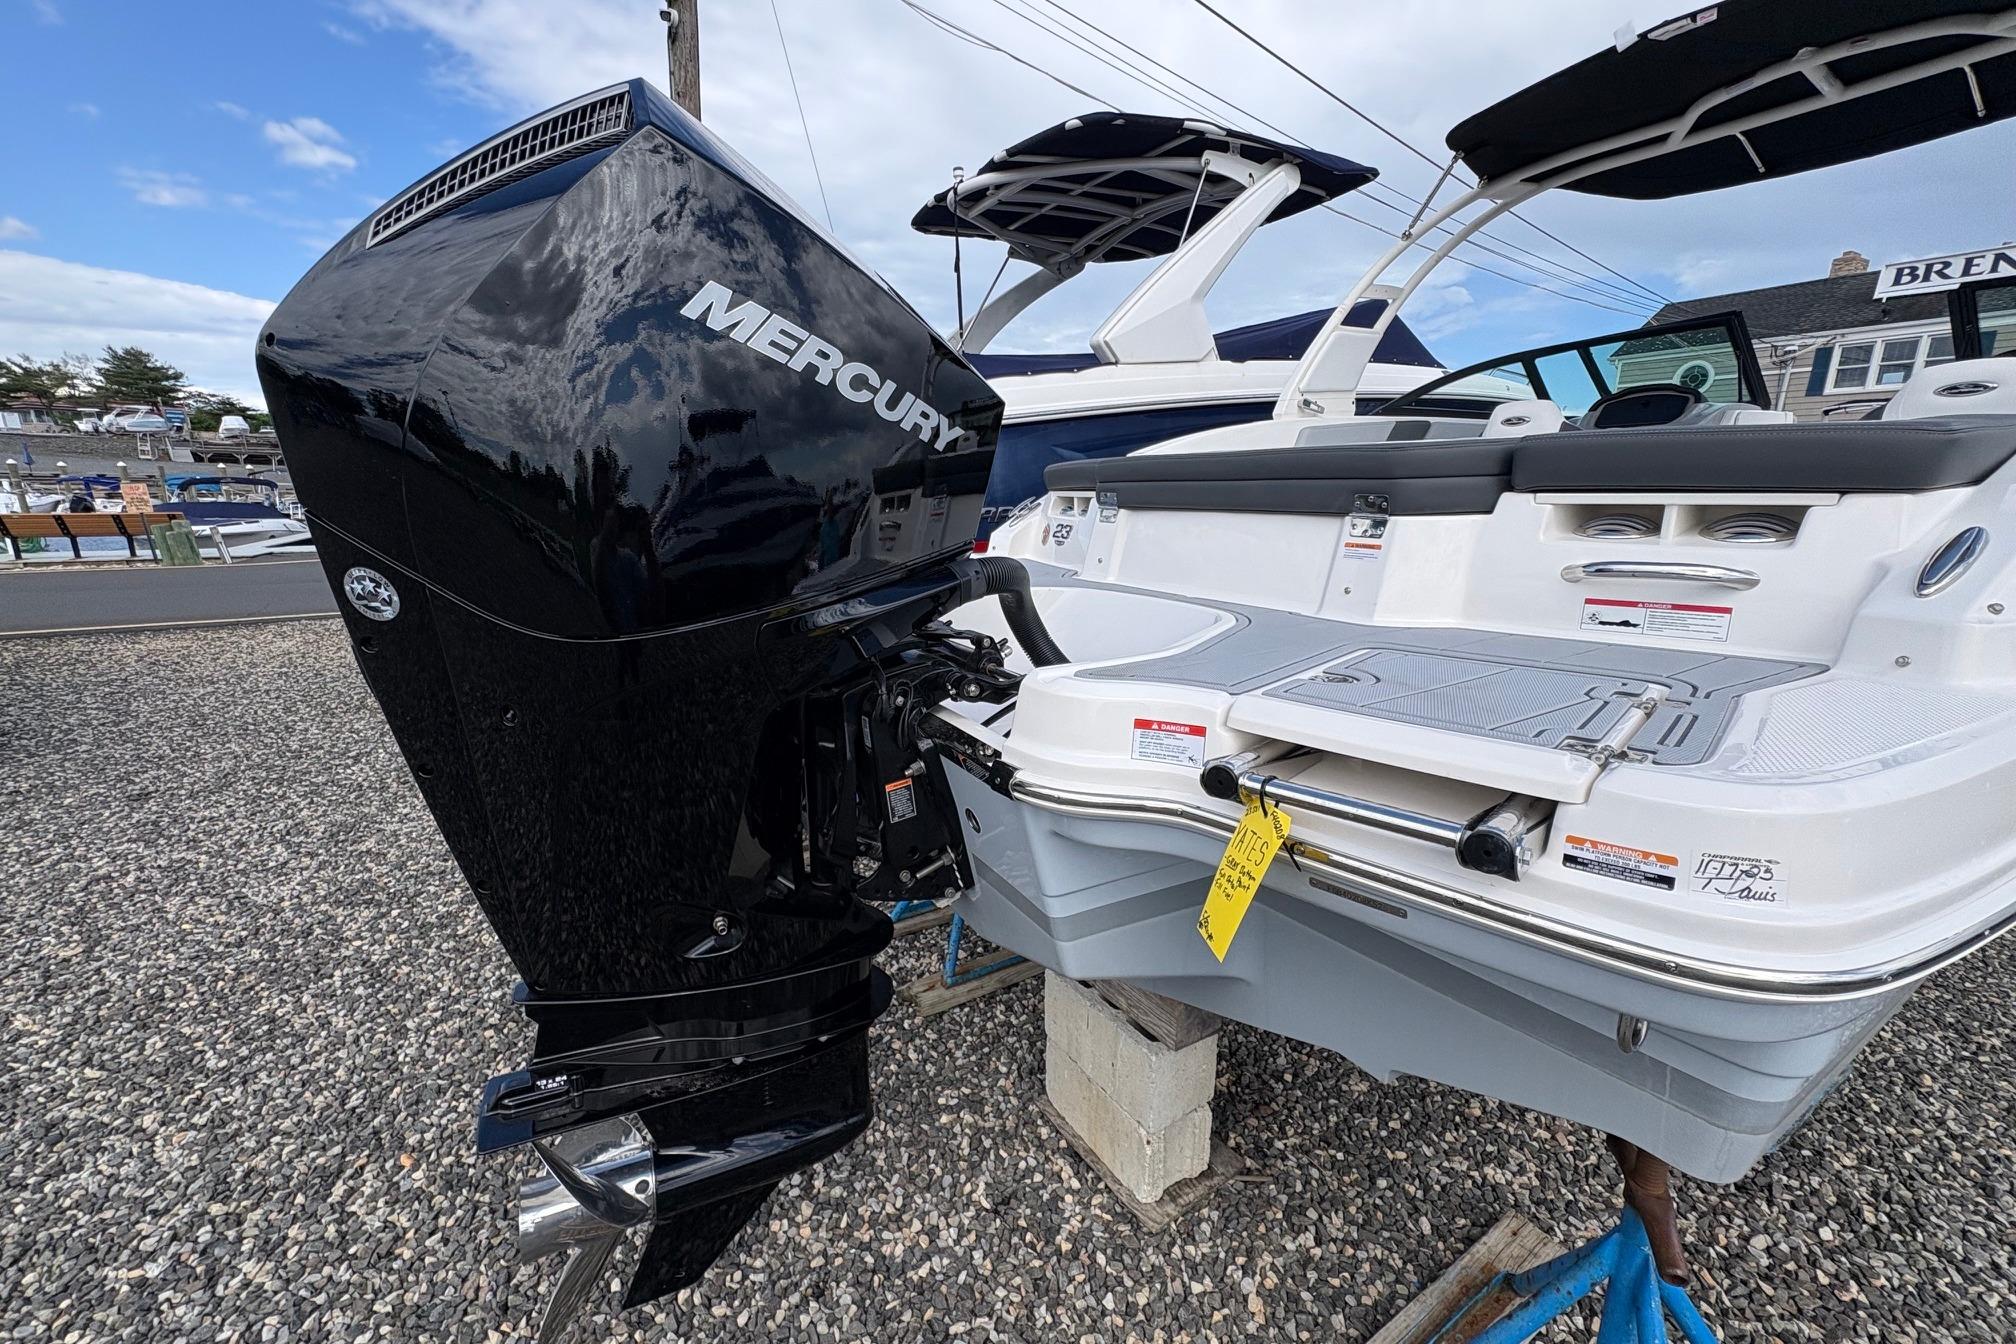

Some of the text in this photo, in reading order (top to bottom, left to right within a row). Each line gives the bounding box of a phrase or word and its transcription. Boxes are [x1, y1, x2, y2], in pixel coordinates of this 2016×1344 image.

[680, 280, 965, 452] MERCURY
[1053, 523, 1073, 539] 23
[1161, 724, 1190, 733] DANGER
[1230, 822, 1269, 867] YATES
[1597, 843, 1643, 858] WARNING
[1585, 847, 1611, 857] PLATFORM
[1612, 853, 1632, 862] PERSON
[1633, 858, 1657, 867] CAPACITY
[1701, 852, 1764, 863] CHAPARRAL
